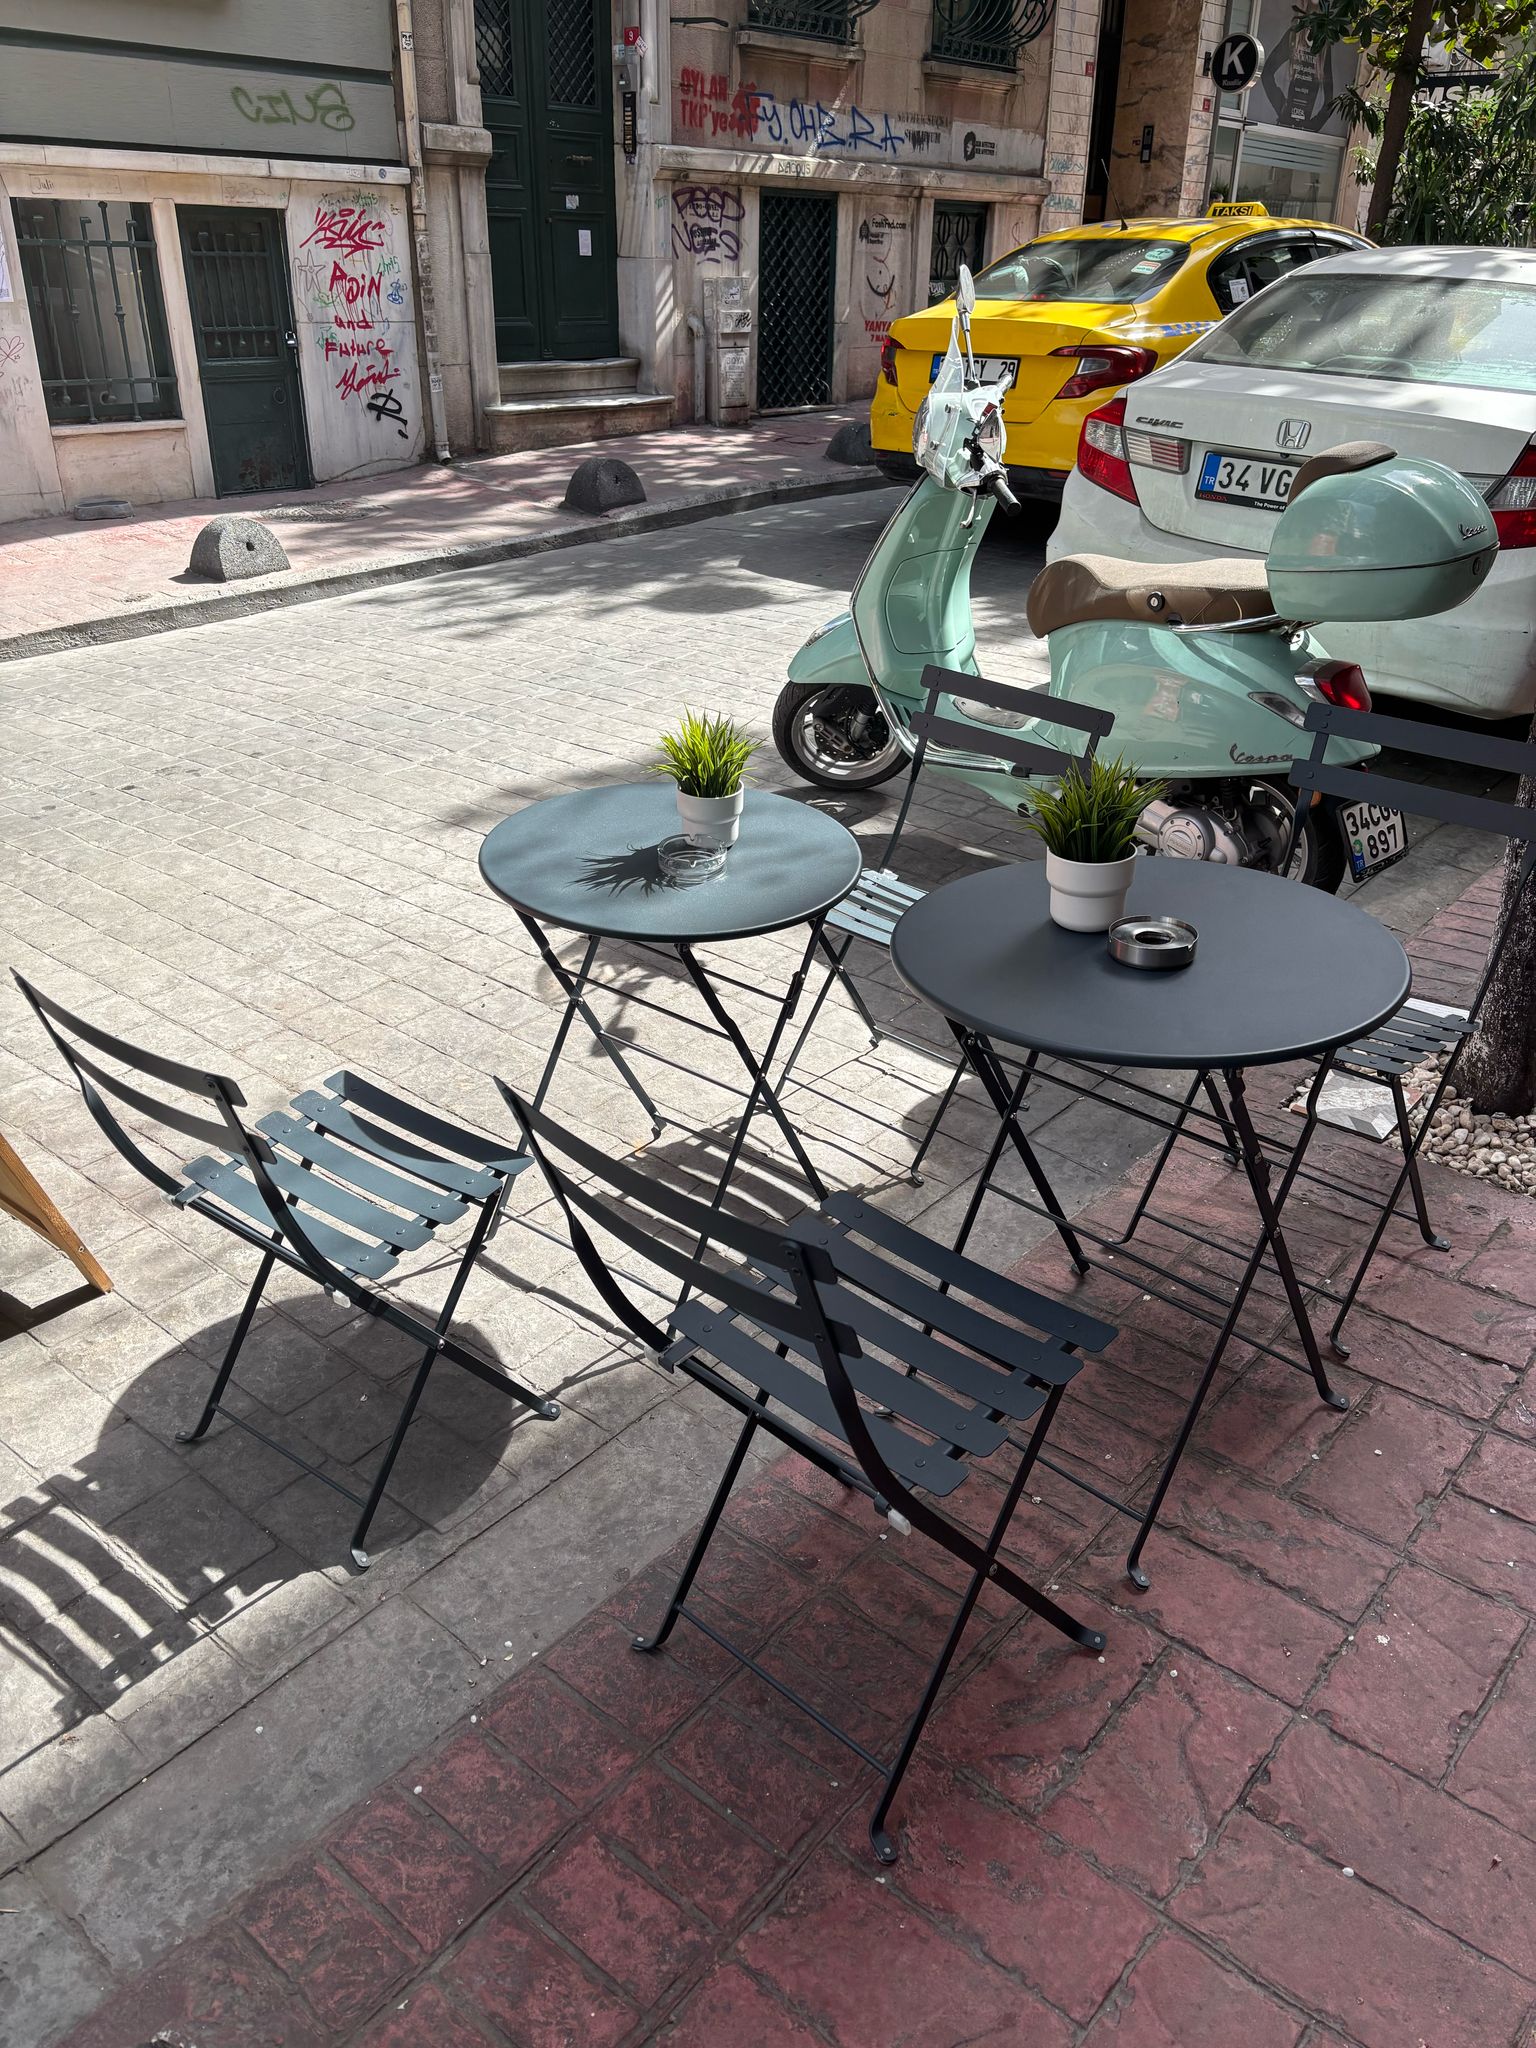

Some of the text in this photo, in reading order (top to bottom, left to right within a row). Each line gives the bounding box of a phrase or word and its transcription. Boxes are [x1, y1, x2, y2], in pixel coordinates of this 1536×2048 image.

[1221, 41, 1249, 76] K
[1204, 462, 1294, 498] TR 34 VG
[1229, 743, 1293, 764] Vespa
[1367, 823, 1397, 859] 897
[1356, 859, 1365, 873] TR
